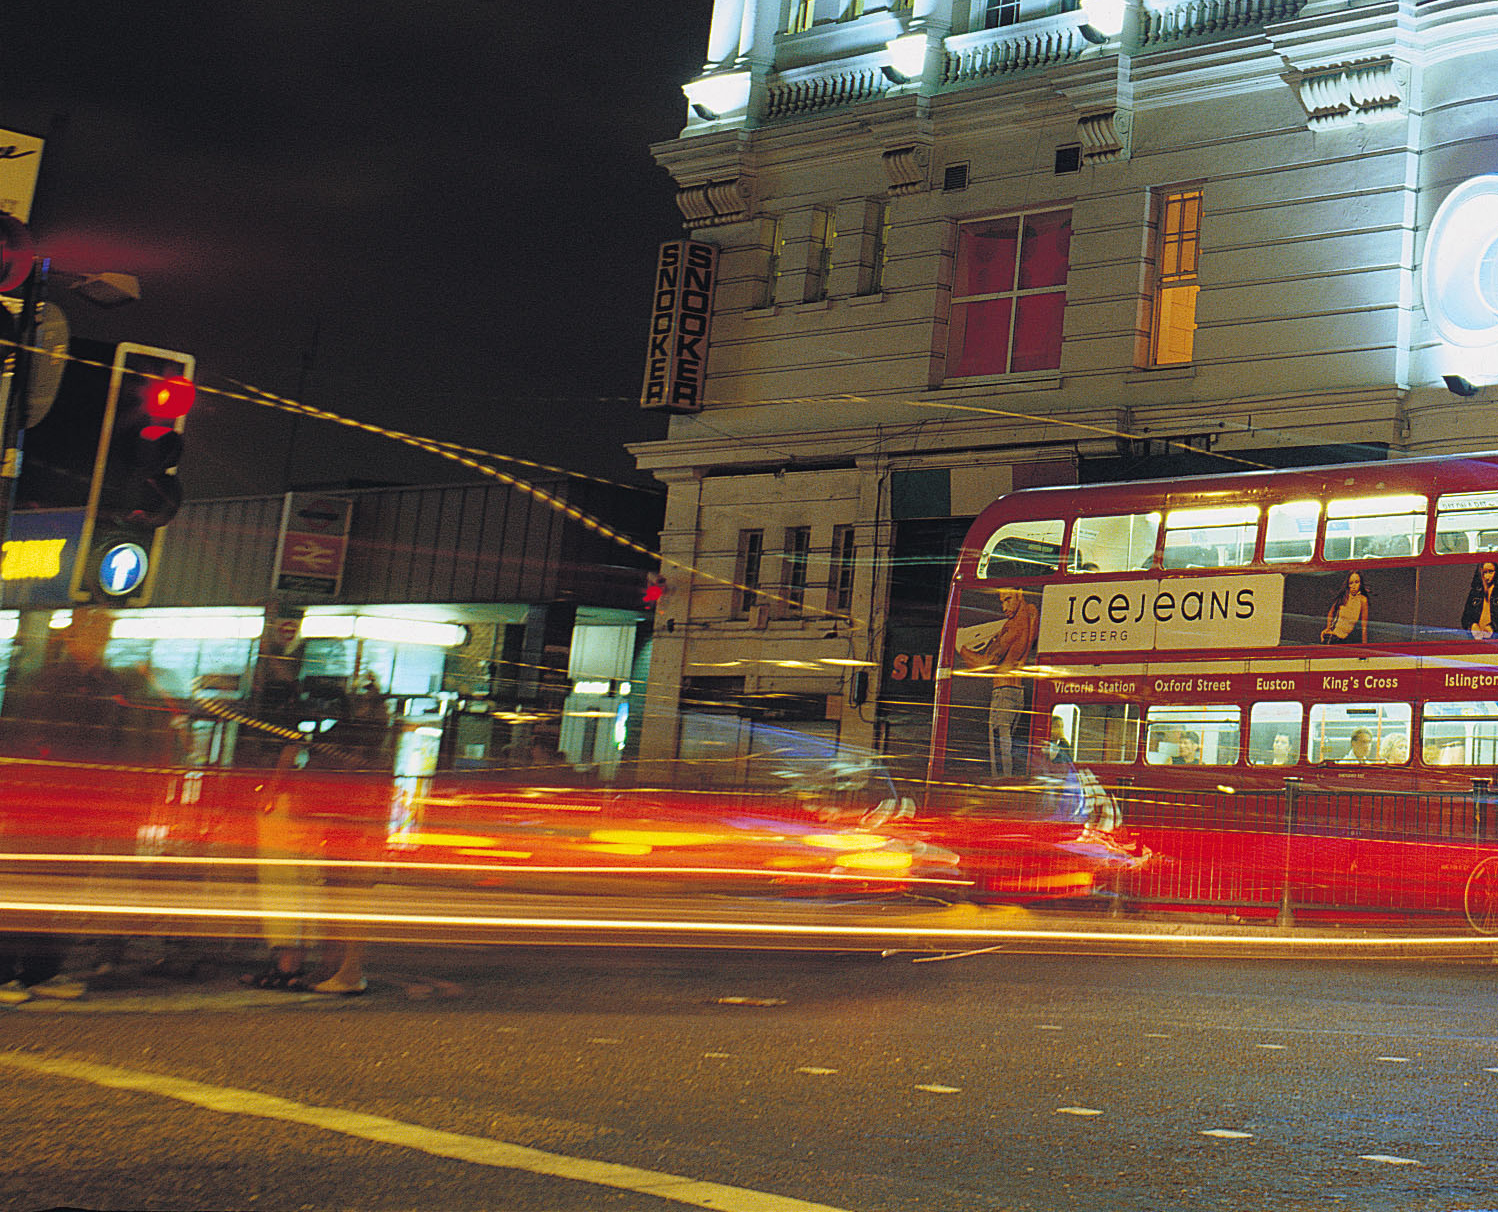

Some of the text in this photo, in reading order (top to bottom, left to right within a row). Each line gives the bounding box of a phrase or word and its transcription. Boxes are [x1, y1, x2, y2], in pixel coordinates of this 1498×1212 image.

[645, 243, 680, 405] SNOOKER
[672, 244, 713, 407] SNOOKER
[1063, 630, 1129, 643] ICEBERG
[890, 653, 936, 681] SN
[1053, 680, 1136, 694] Victoria Station
[1154, 678, 1232, 692] Oxford Street
[1256, 678, 1296, 691] Euston
[1322, 675, 1399, 692] King's Cross
